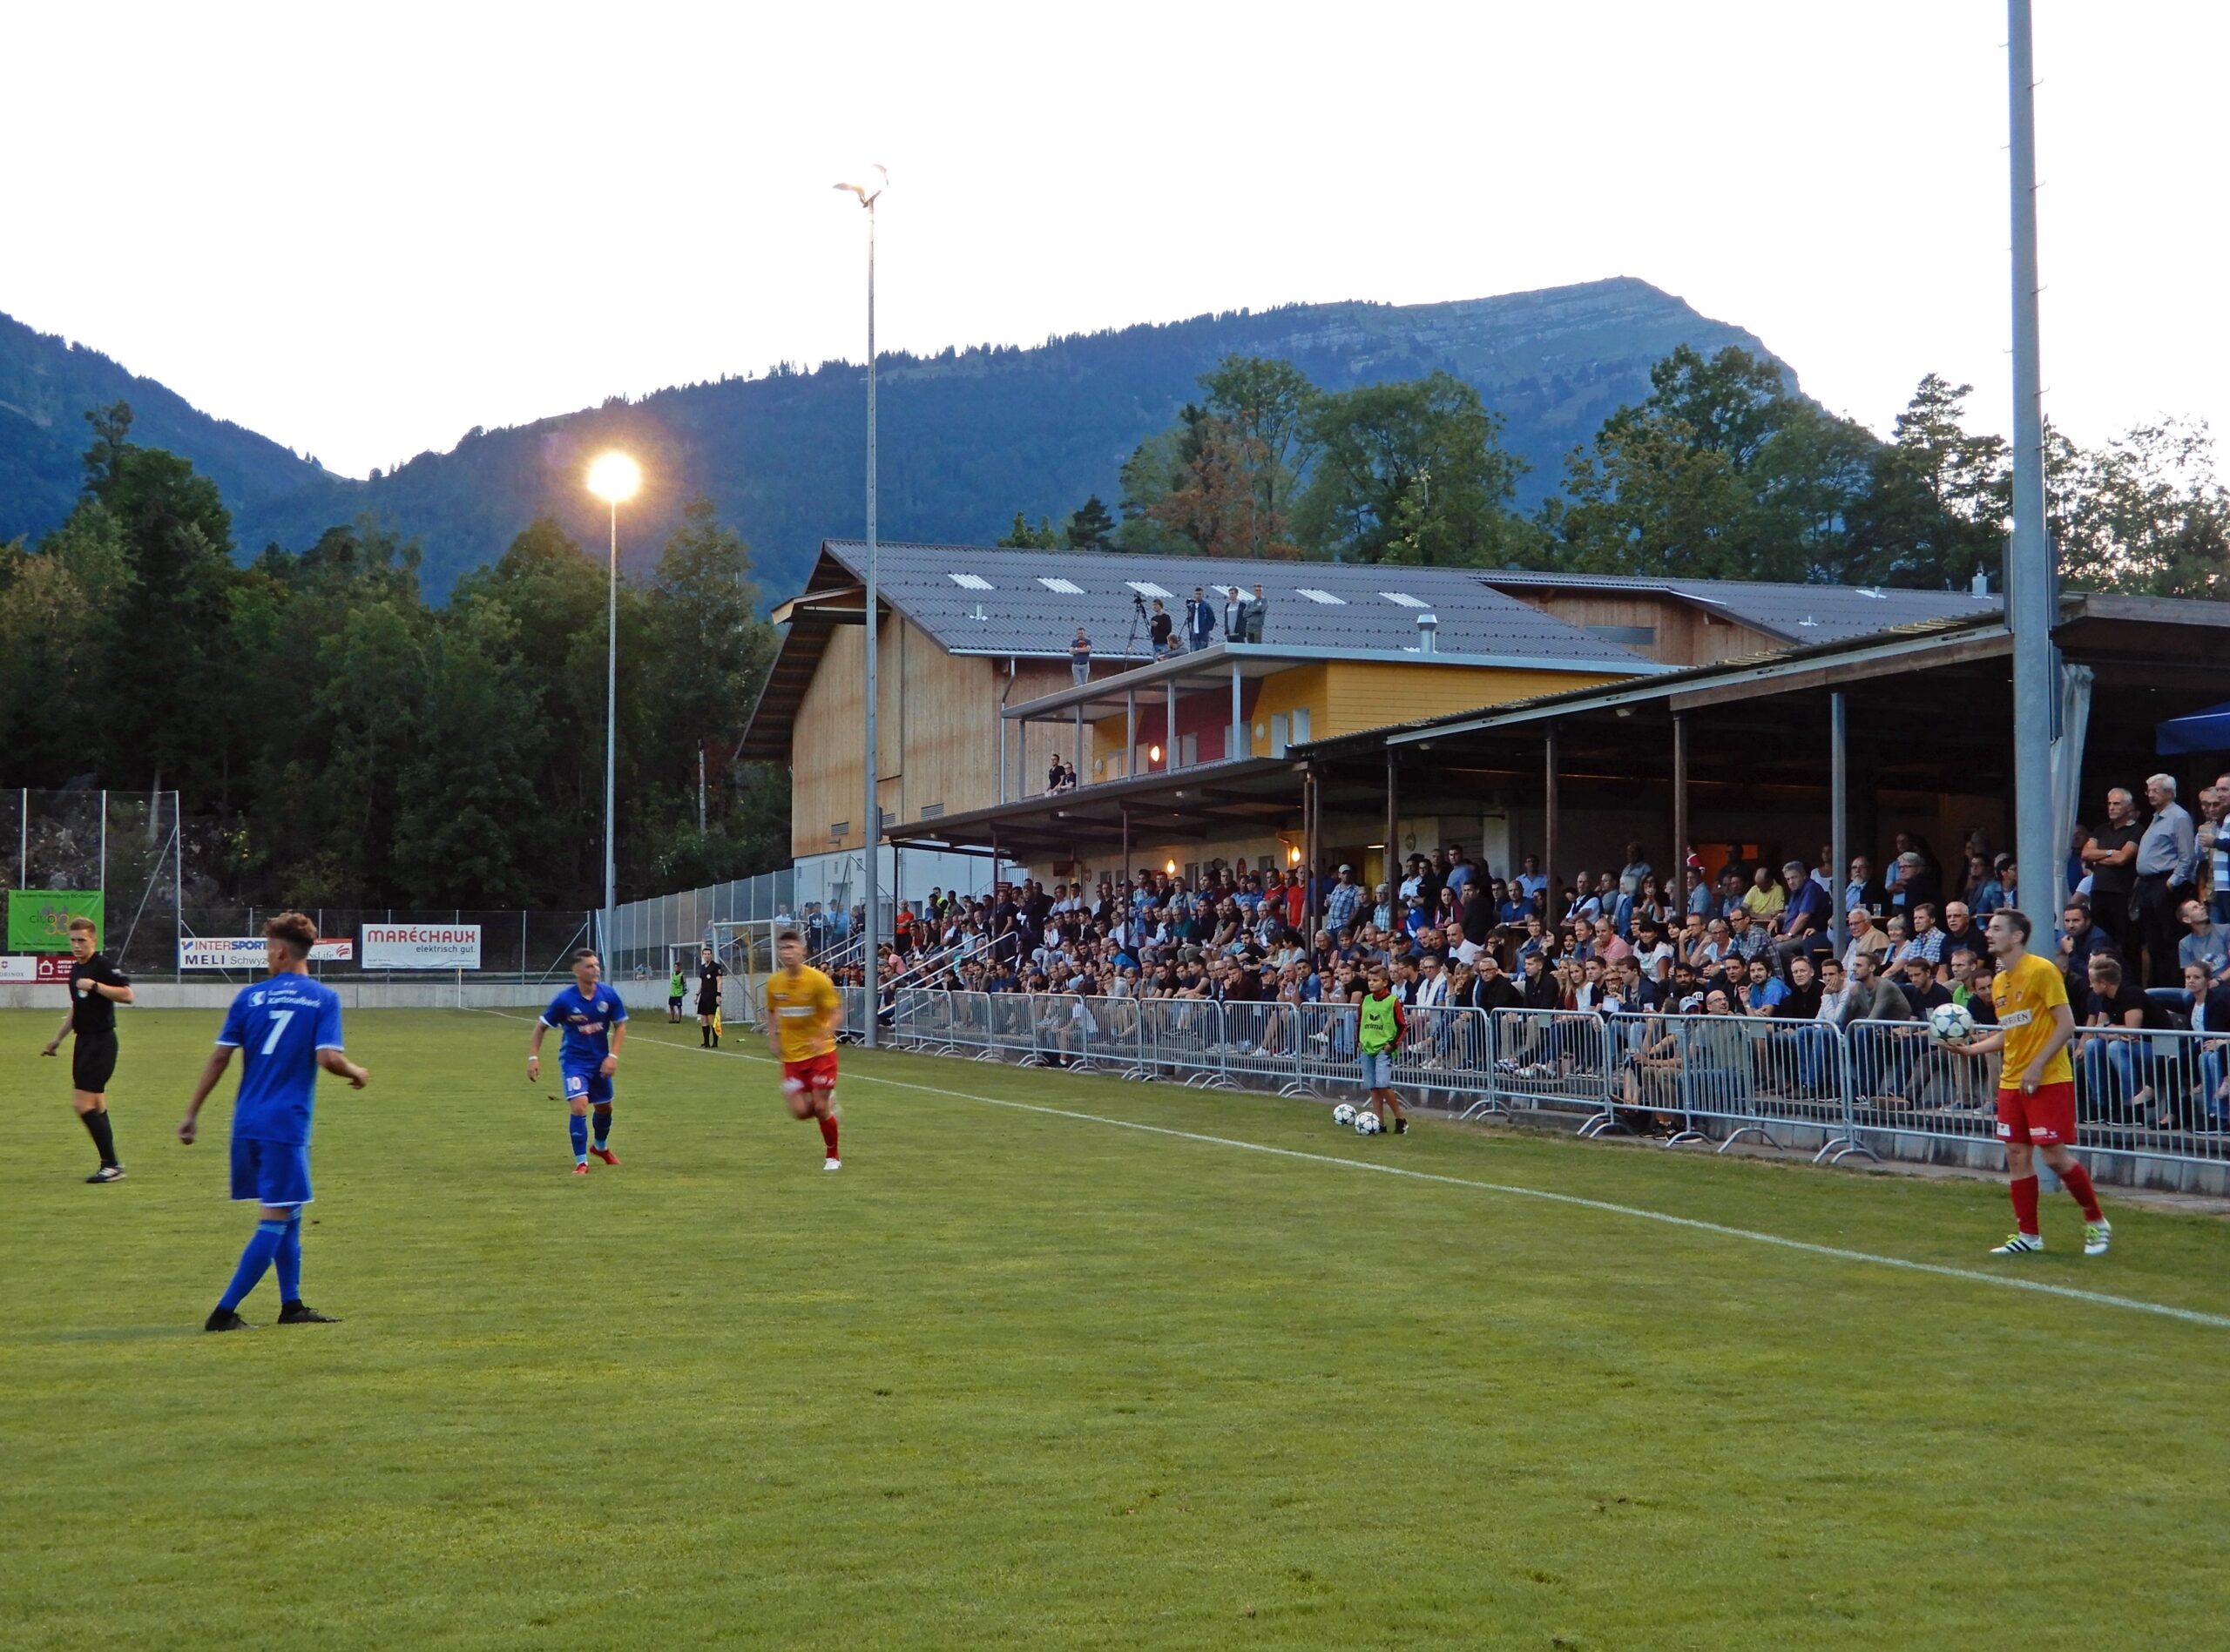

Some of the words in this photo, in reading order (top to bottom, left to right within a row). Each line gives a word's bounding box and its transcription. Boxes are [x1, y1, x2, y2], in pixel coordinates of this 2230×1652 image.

[368, 927, 476, 943] MARÉCHAUX
[194, 941, 267, 951] INTERSPORT
[460, 946, 476, 954] gut.
[185, 954, 225, 965] MELI
[261, 1010, 295, 1055] 7
[566, 1076, 582, 1092] 10
